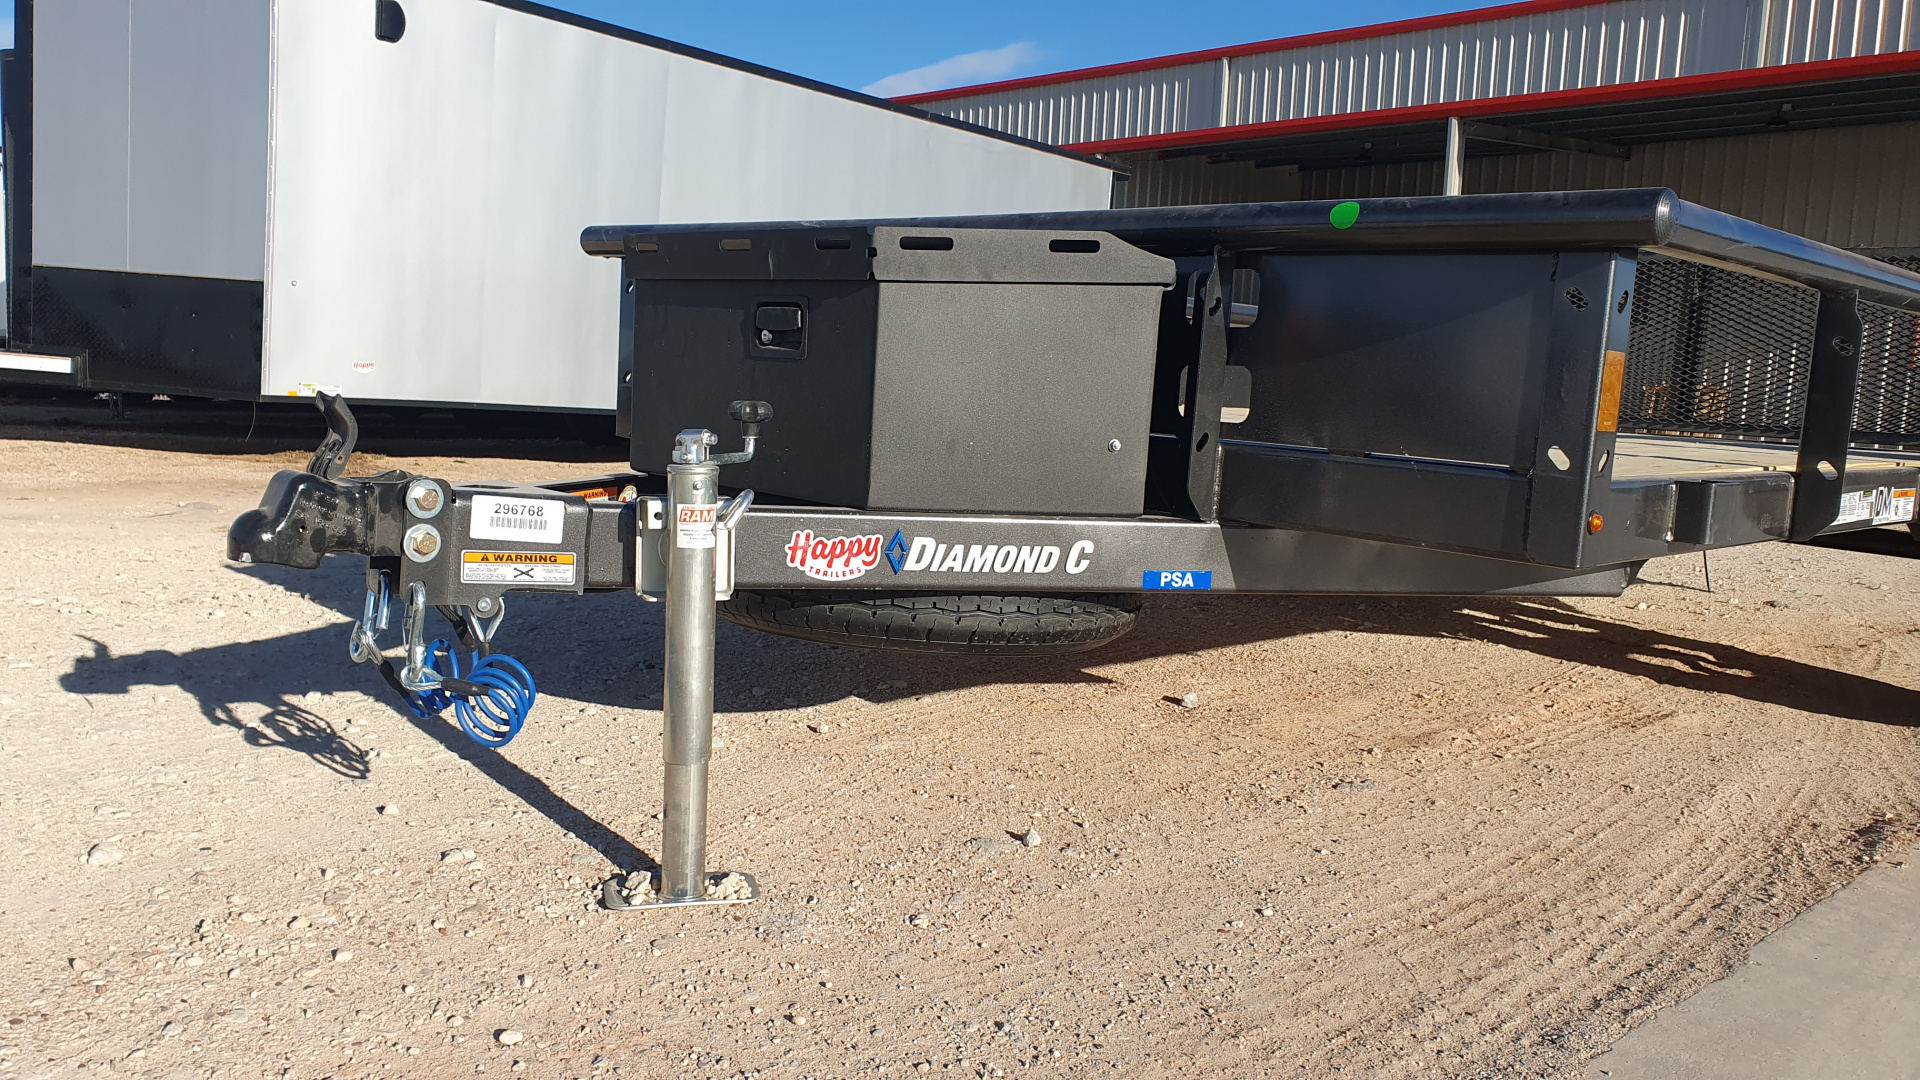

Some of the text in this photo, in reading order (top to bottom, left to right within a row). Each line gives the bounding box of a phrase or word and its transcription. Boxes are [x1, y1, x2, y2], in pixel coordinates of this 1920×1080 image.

[353, 361, 375, 369] Happy
[494, 503, 544, 517] 296768
[680, 510, 714, 522] RAM
[788, 532, 880, 568] Happy
[903, 536, 1094, 575] DIAMOND C
[493, 554, 558, 563] WARNING
[808, 566, 862, 578] TRAILERS
[1159, 571, 1194, 587] PSA
